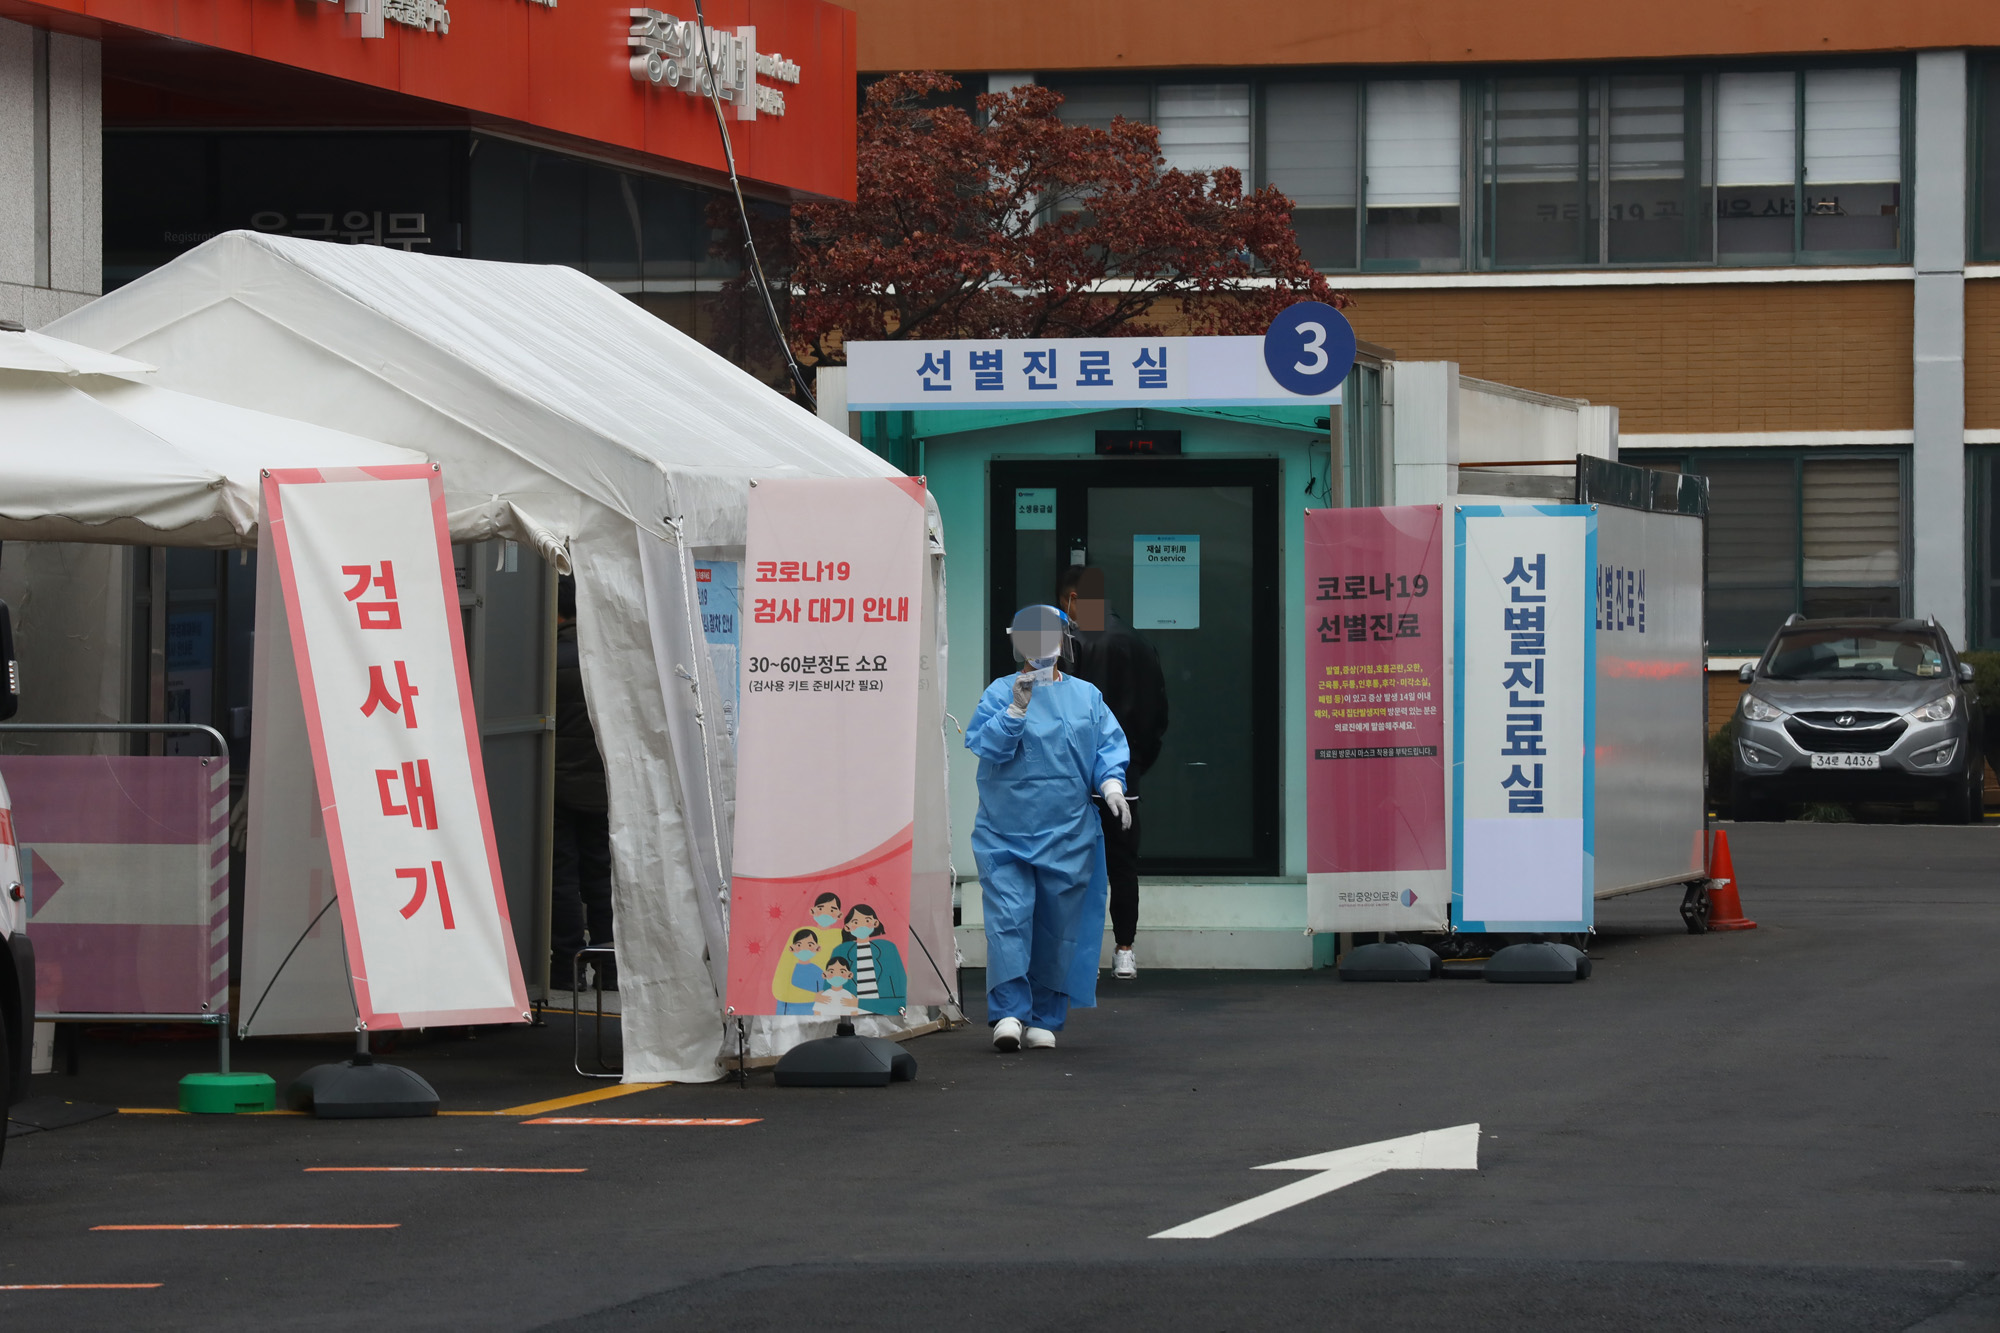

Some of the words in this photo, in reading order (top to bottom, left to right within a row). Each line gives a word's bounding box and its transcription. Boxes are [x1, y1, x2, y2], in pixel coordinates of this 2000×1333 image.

[916, 346, 1168, 391] 선별진료실
[1293, 321, 1329, 375] 3
[1146, 545, 1161, 554] 재실
[1163, 545, 1187, 554] 可利用
[755, 560, 851, 583] 코로나19
[1316, 572, 1429, 601] 코로나19
[1596, 563, 1646, 634] 선별진료실
[753, 597, 802, 623] 검사
[808, 597, 854, 623] 대기
[862, 596, 909, 622] 안내
[1316, 613, 1421, 643] 선별진료
[748, 655, 850, 674] 30~60분정도
[855, 655, 888, 672] 소요
[748, 680, 784, 693] (검사용
[788, 680, 809, 691] 키트
[812, 680, 855, 692] 준비시간
[858, 679, 884, 692] 필요)
[1500, 553, 1547, 814] 선별진료실
[1352, 693, 1367, 703] 있고
[1368, 693, 1382, 703] 증상
[1384, 693, 1398, 702] 발생
[1400, 692, 1415, 701] 14일
[1417, 692, 1431, 701] 이내
[1331, 709, 1345, 718] 국내
[1408, 706, 1422, 716] 있는
[1334, 722, 1370, 732] 의료진에게
[341, 559, 455, 930] 검사대기
[1319, 749, 1338, 759] 의료원
[1338, 749, 1356, 758] 방문시
[1357, 748, 1376, 757] 마스크
[1376, 748, 1394, 757] 착용을
[1816, 755, 1839, 767] 34로
[1844, 755, 1874, 767] 4436
[1338, 891, 1399, 903] 국립중앙의료원
